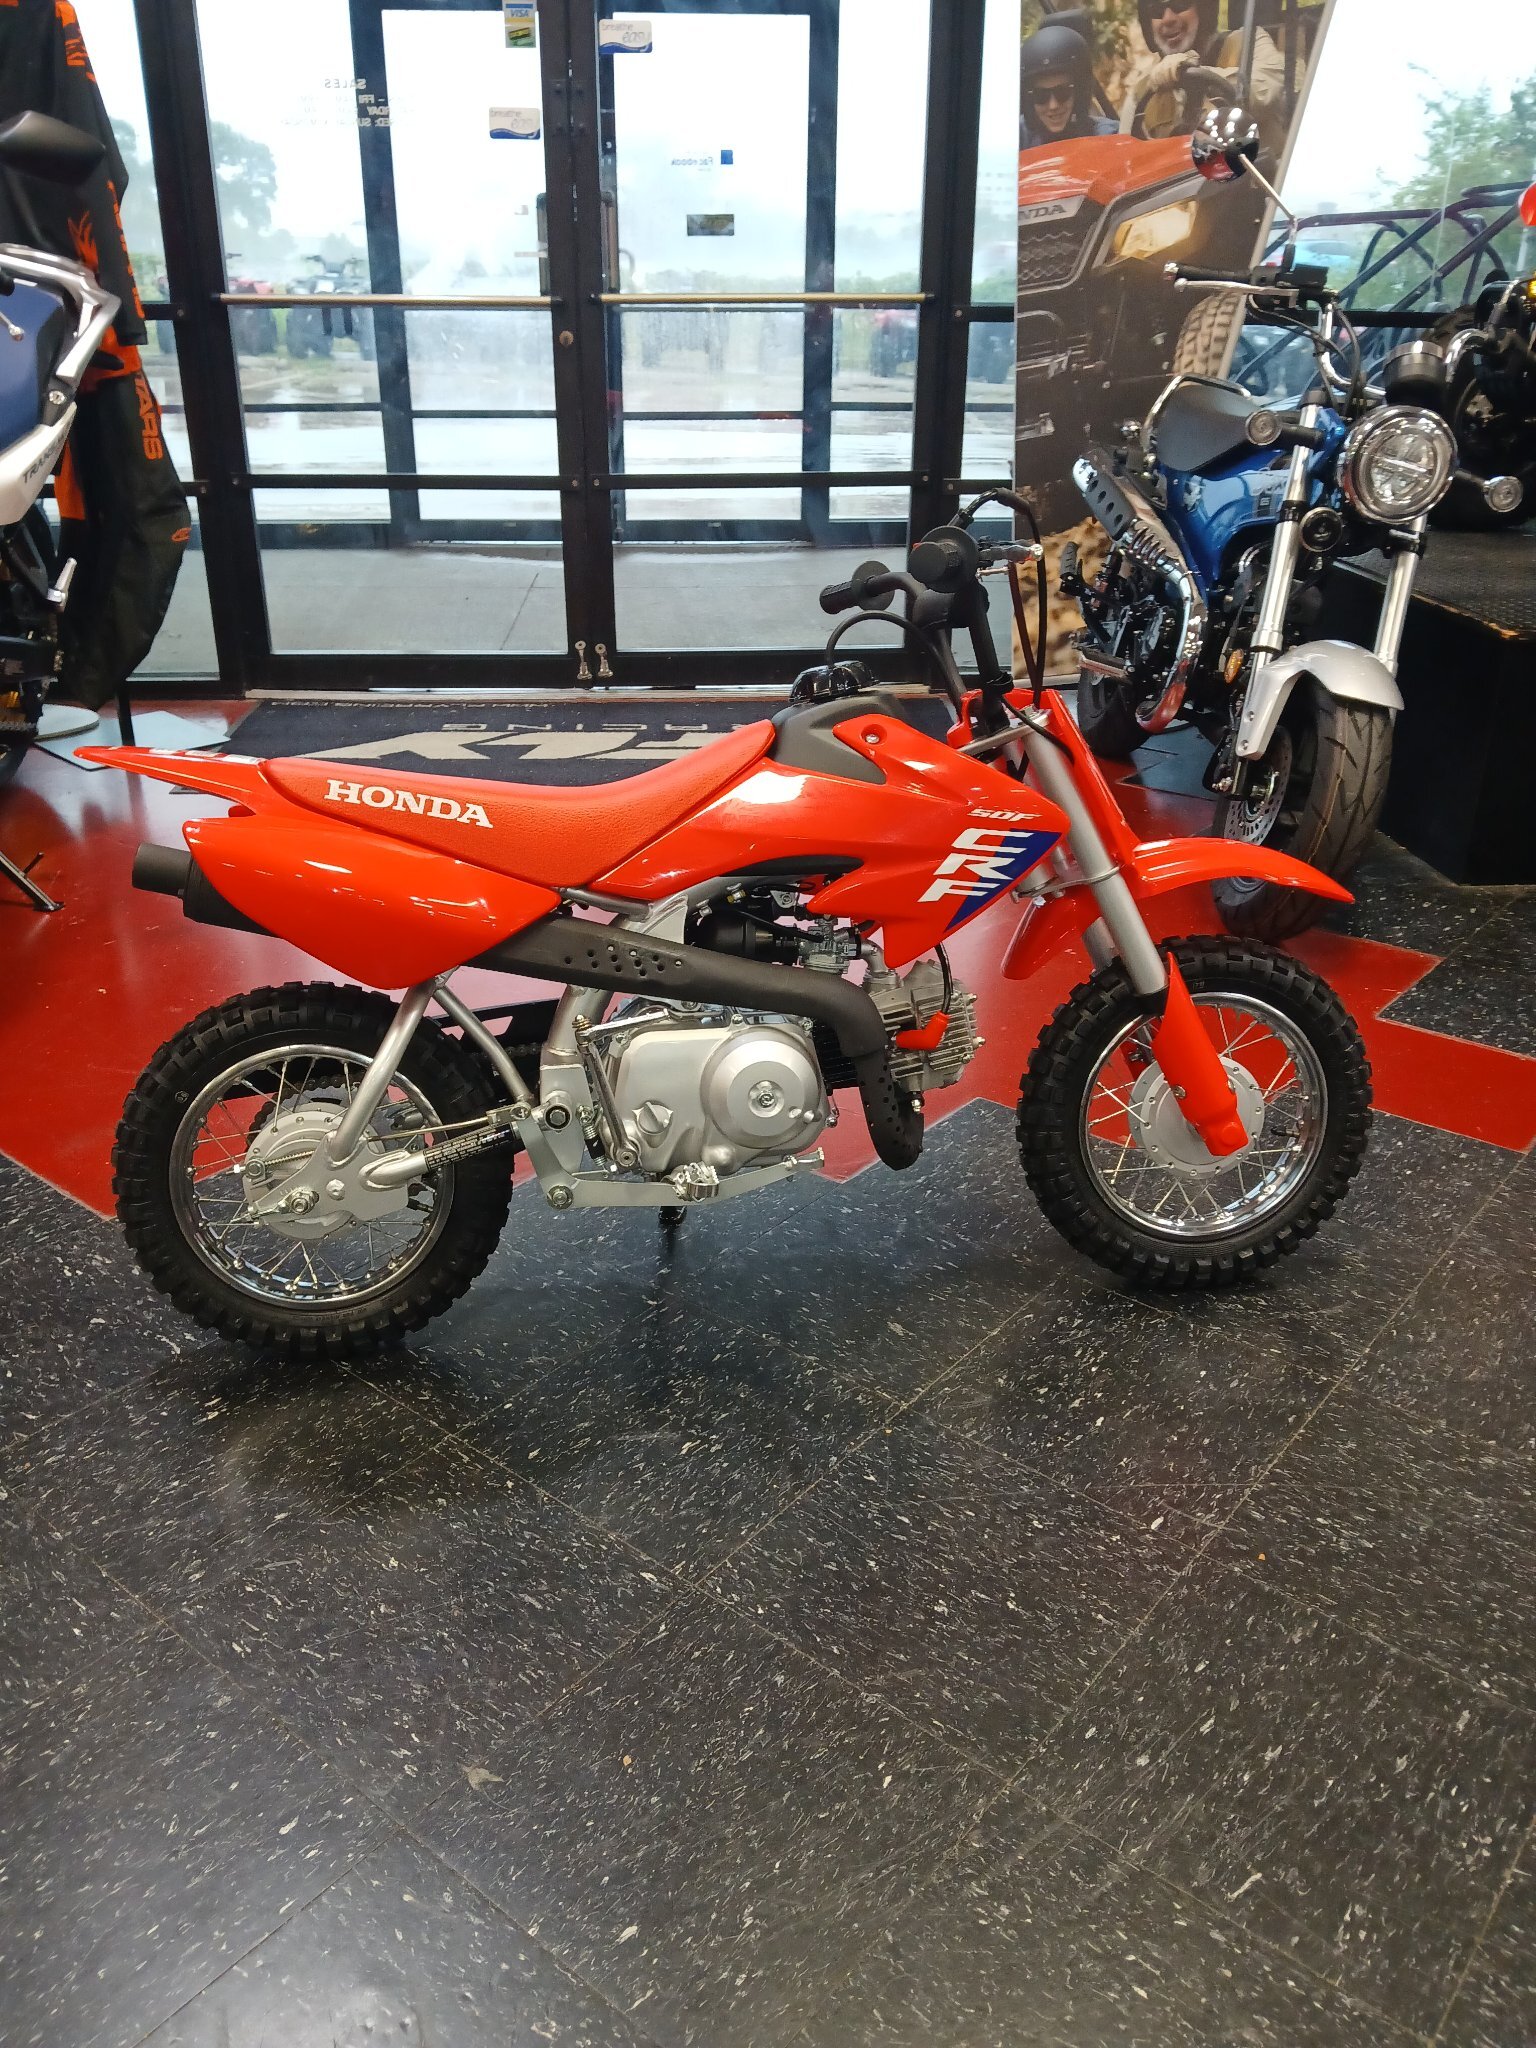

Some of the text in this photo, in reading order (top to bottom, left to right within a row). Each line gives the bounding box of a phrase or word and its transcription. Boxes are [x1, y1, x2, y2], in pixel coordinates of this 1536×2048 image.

[511, 9, 529, 17] VISA
[324, 779, 494, 829] HONDA
[967, 808, 1043, 822] 50F
[917, 827, 1034, 903] CRF
